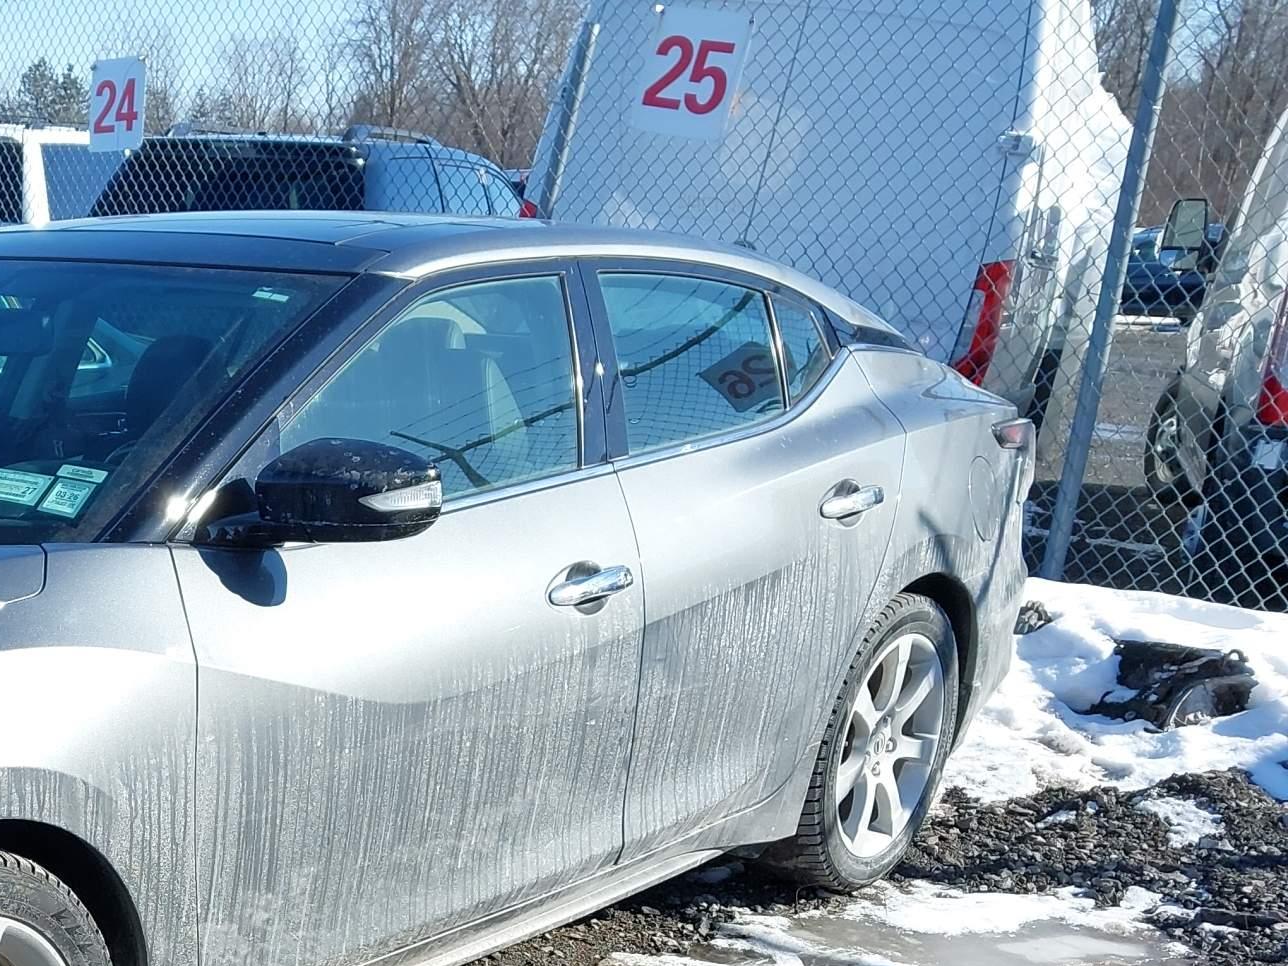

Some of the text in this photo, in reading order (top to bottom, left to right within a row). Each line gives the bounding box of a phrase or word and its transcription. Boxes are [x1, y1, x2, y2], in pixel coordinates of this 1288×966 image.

[642, 35, 736, 115] 25
[94, 78, 138, 134] 24
[21, 486, 38, 496] 27
